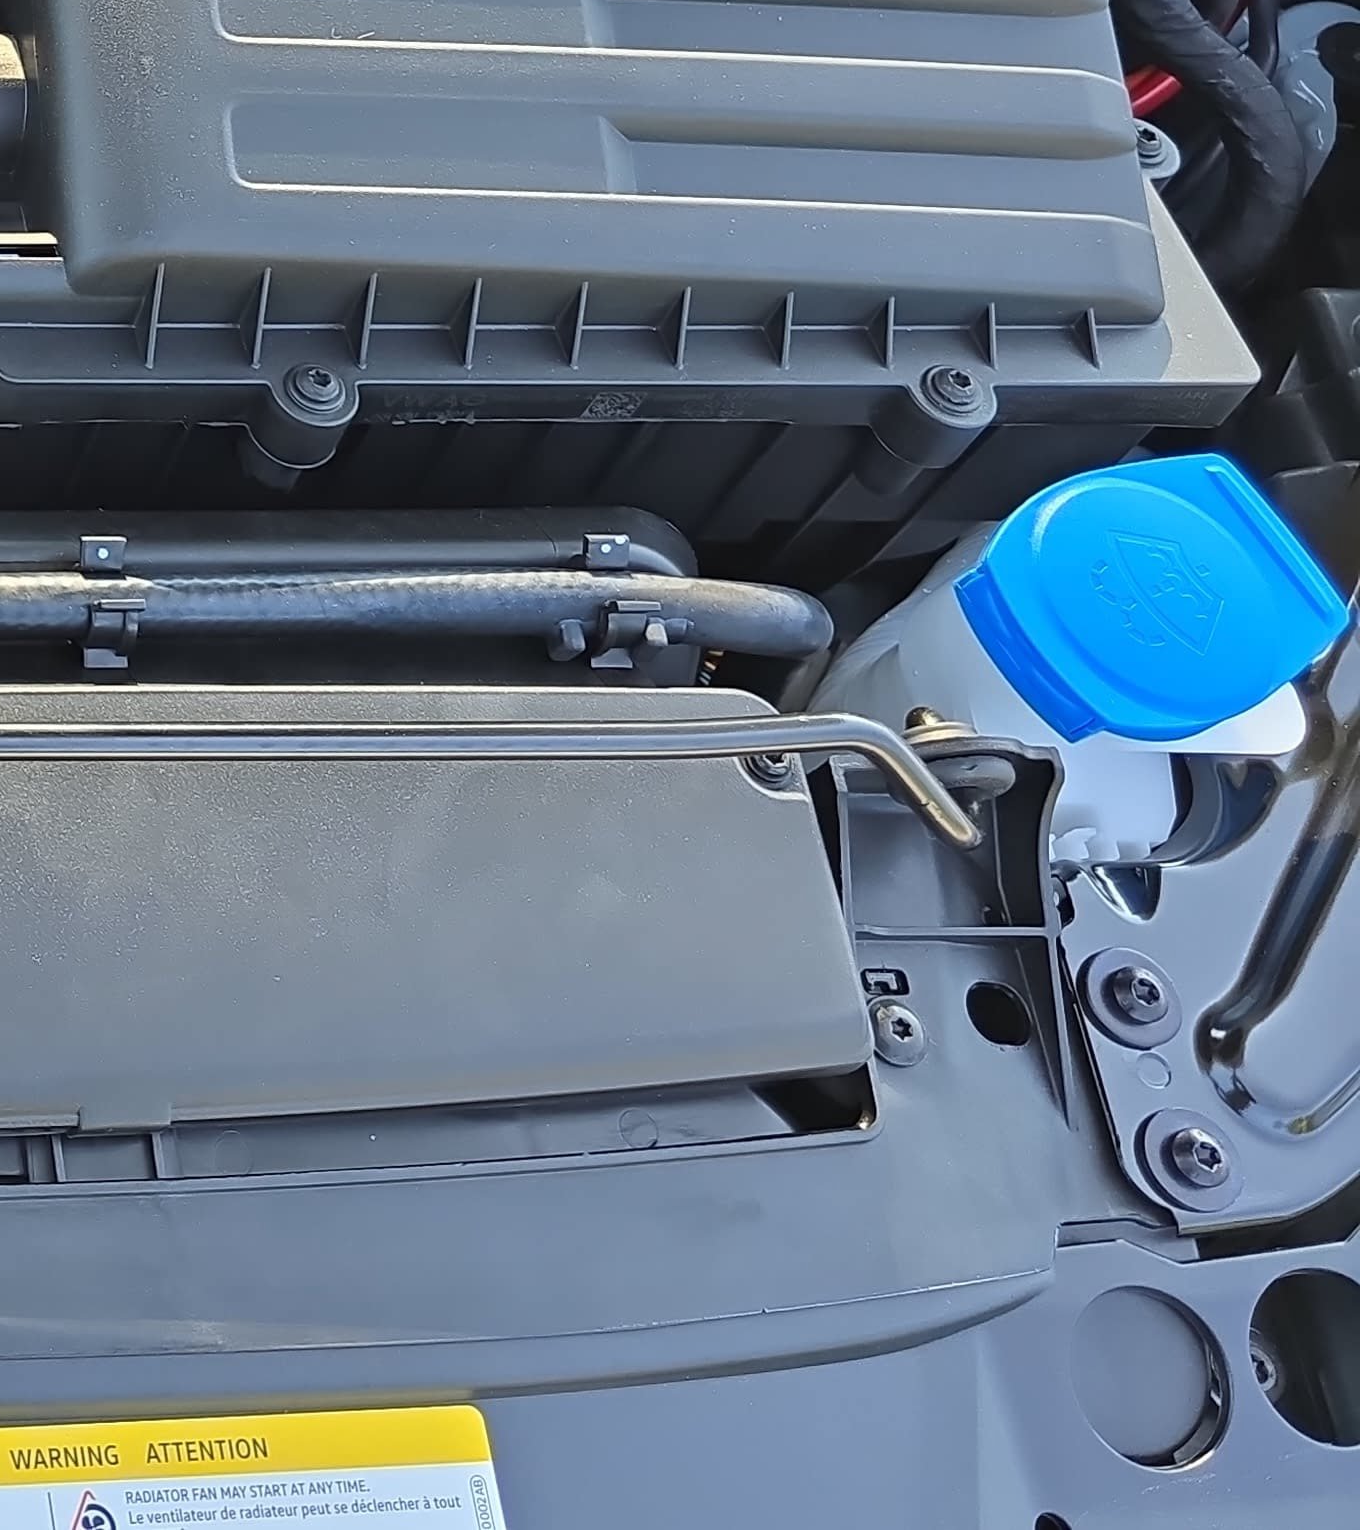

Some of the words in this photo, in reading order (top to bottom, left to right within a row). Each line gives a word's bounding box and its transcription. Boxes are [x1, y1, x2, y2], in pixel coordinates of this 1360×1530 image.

[10, 1444, 120, 1470] WARNING
[146, 1437, 269, 1464] ATTENTION
[126, 1487, 189, 1504] RADIATOR
[192, 1486, 218, 1502] FAN
[220, 1485, 248, 1500] MAY
[250, 1482, 288, 1499] START
[290, 1482, 306, 1496] AT
[308, 1480, 333, 1495] ANY
[336, 1479, 370, 1493] TIME.
[128, 1510, 144, 1525] Le
[147, 1507, 216, 1524] ventilateur
[220, 1506, 236, 1521] de
[239, 1504, 298, 1520] radiateur
[300, 1502, 330, 1519] peut
[334, 1503, 348, 1514] se
[351, 1498, 420, 1513] déclencher
[422, 1496, 431, 1509] à
[434, 1496, 462, 1509] tout
